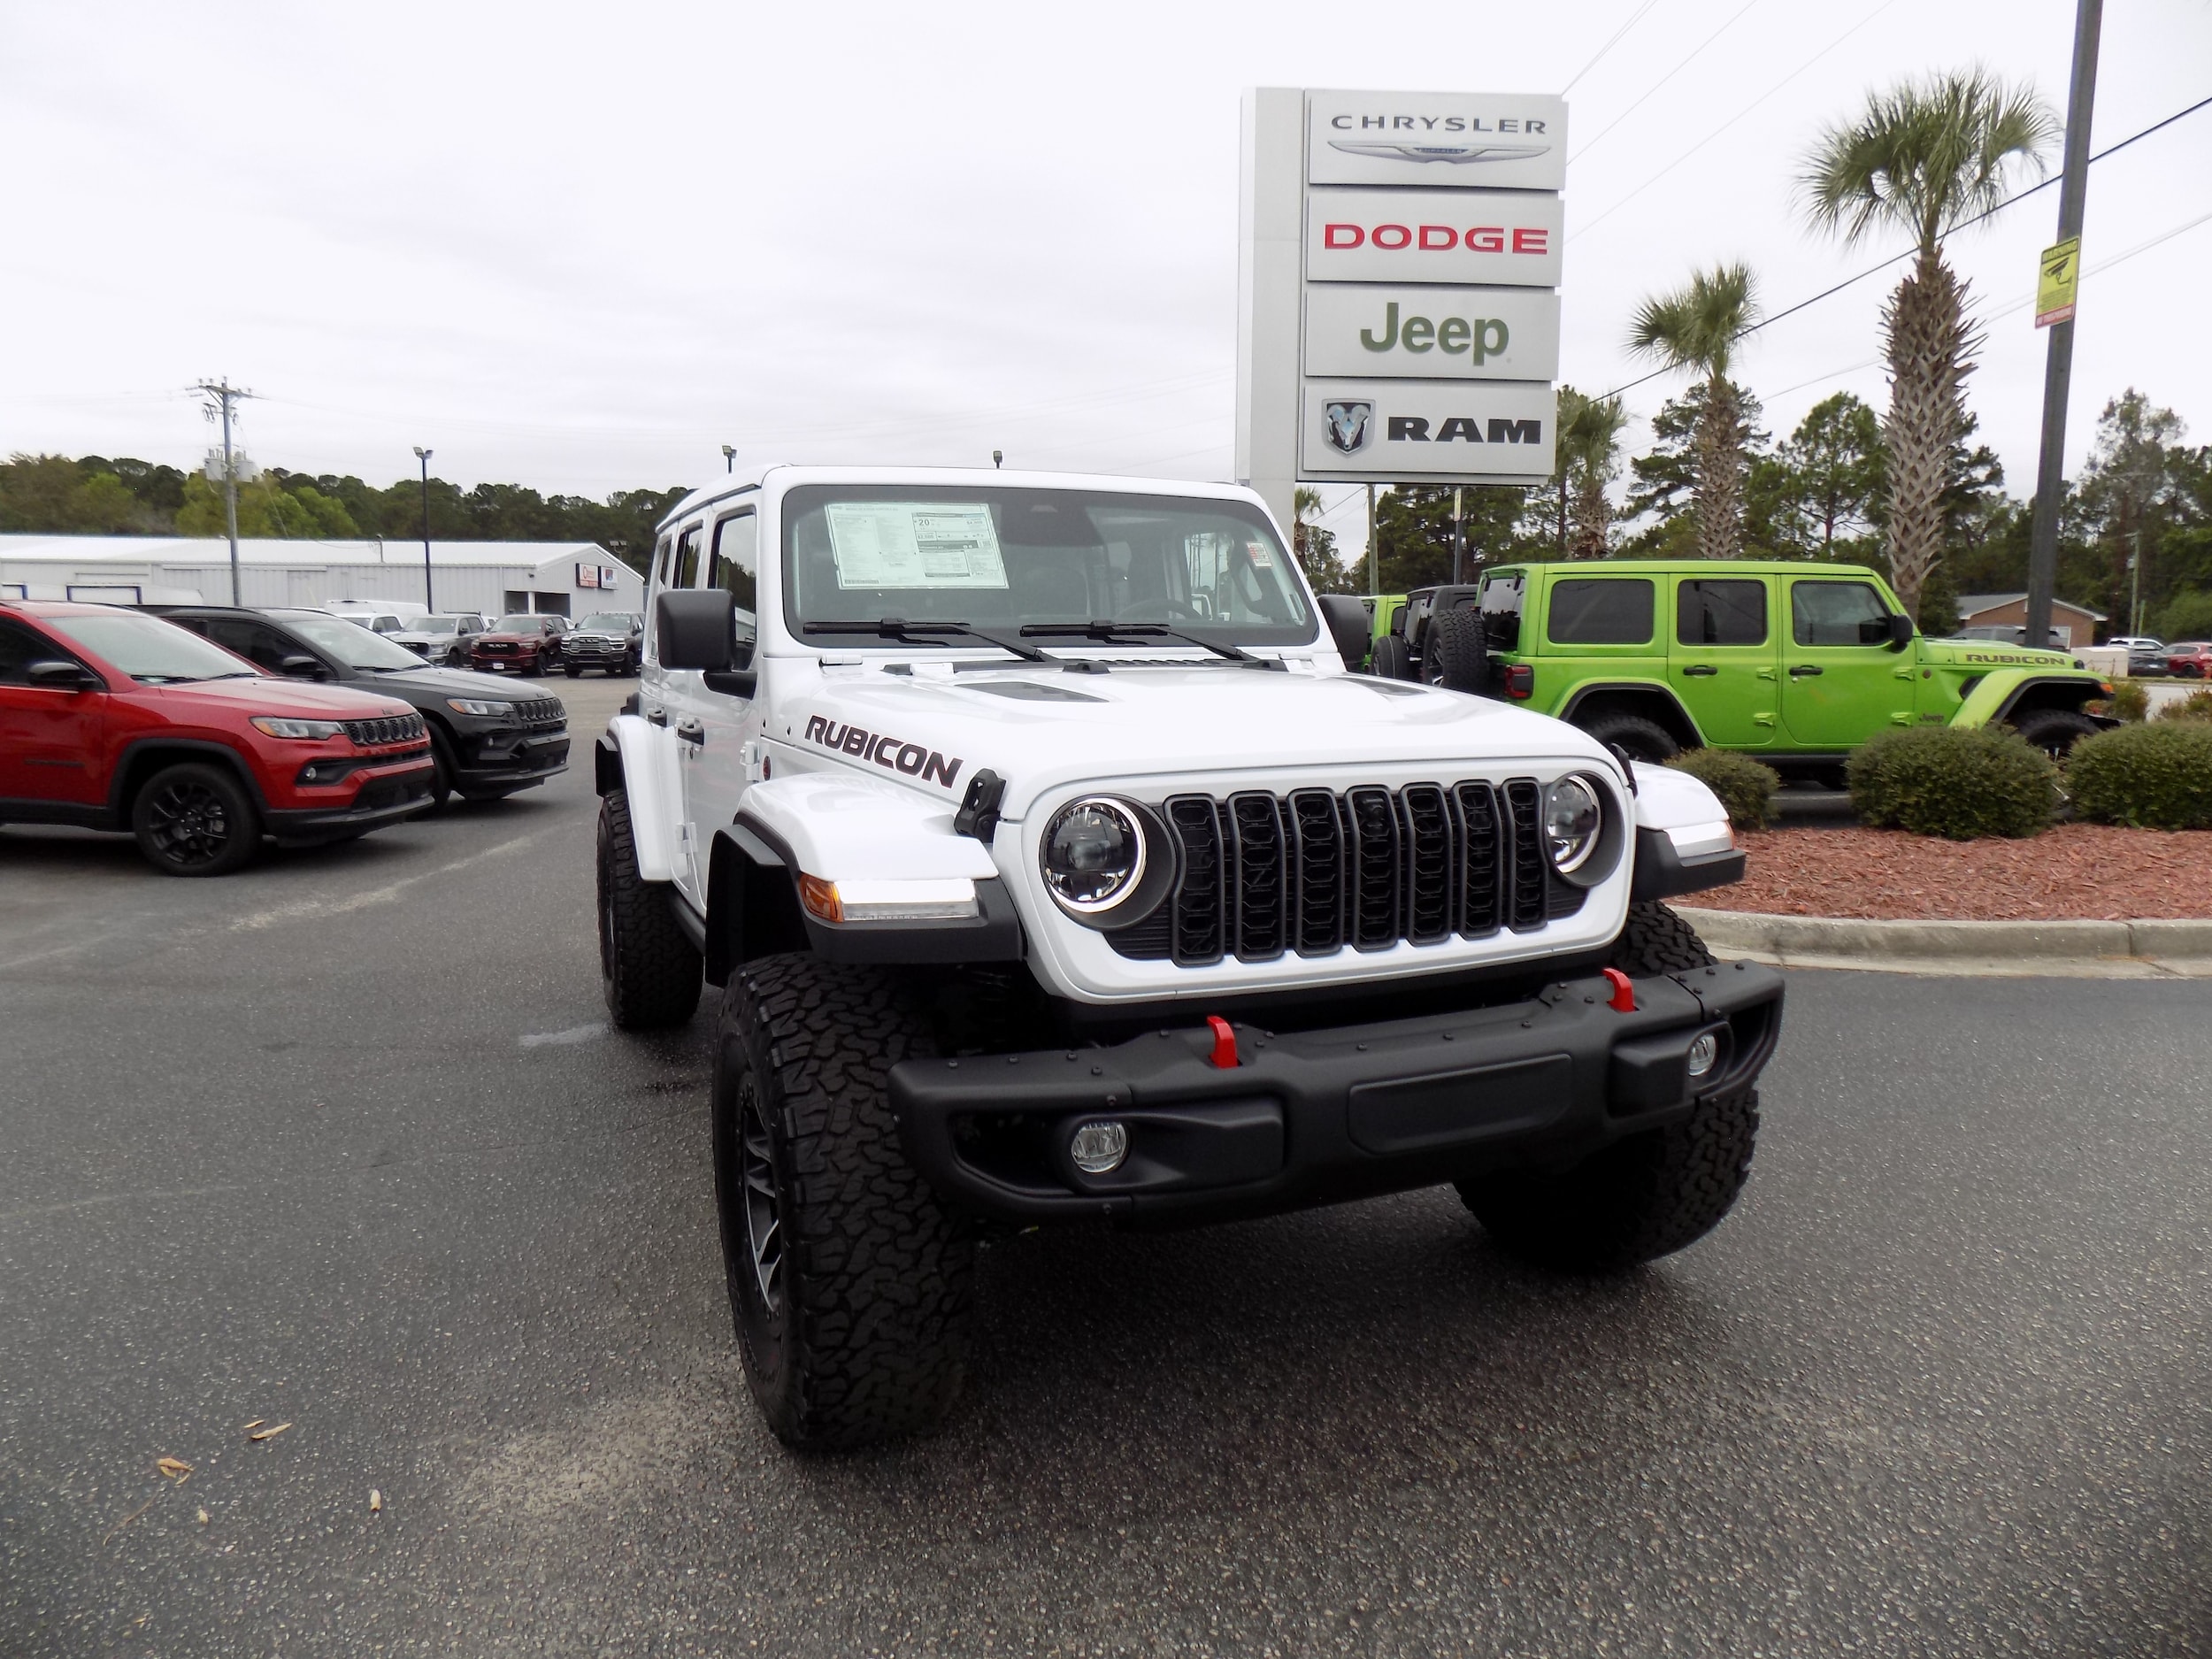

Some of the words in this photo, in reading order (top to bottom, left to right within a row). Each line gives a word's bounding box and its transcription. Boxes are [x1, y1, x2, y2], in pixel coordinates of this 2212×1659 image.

[1331, 115, 1547, 134] CHRYSLER
[1324, 223, 1548, 255] DODGE
[1359, 302, 1509, 366] Jeep
[1387, 416, 1542, 444] RAM
[1965, 654, 2066, 665] RUBICON
[804, 714, 964, 789] RUBICON
